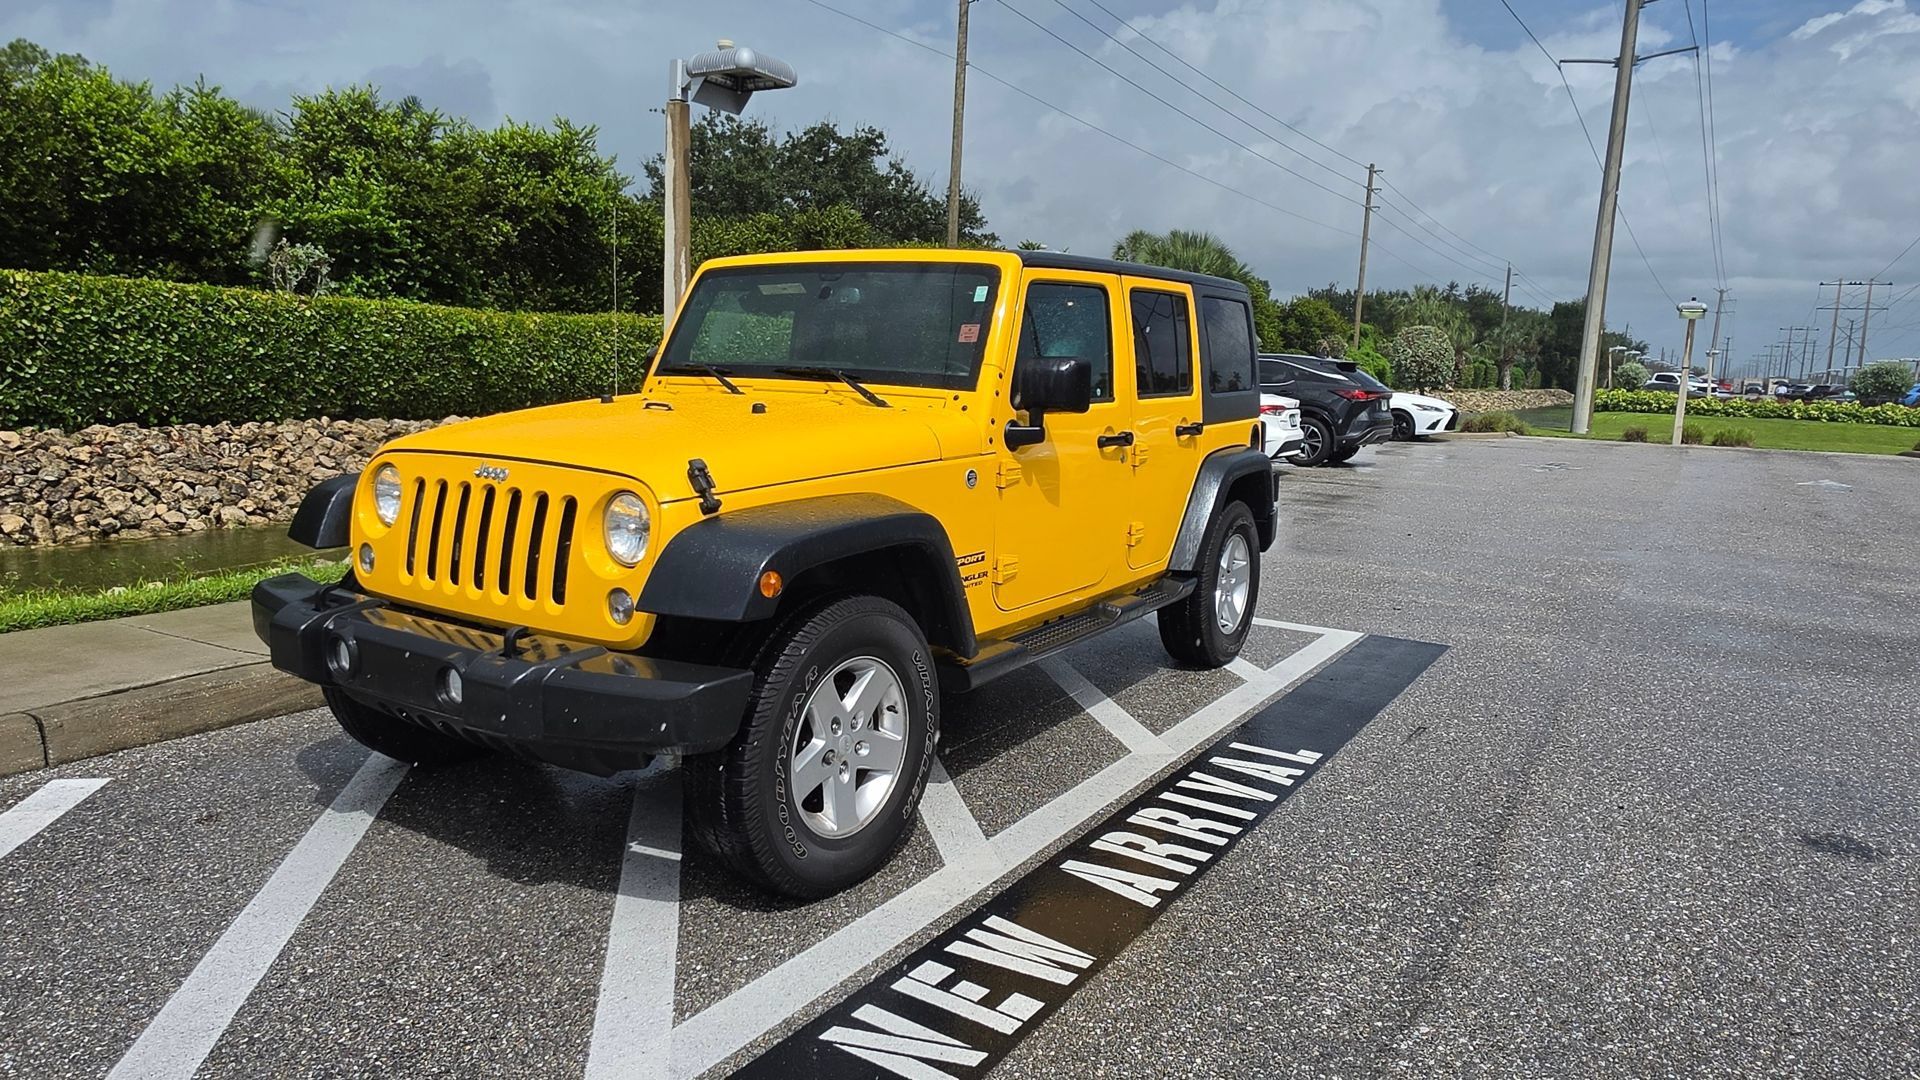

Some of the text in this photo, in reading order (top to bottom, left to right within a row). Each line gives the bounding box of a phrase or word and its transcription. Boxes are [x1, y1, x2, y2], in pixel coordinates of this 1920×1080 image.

[473, 460, 509, 484] Jeep
[956, 552, 985, 566] PORT
[961, 571, 988, 582] NGLER
[775, 665, 818, 859] GOODYEAR
[903, 650, 936, 819] WRANGLER
[818, 742, 1323, 1080] NEW ARRIVAL
